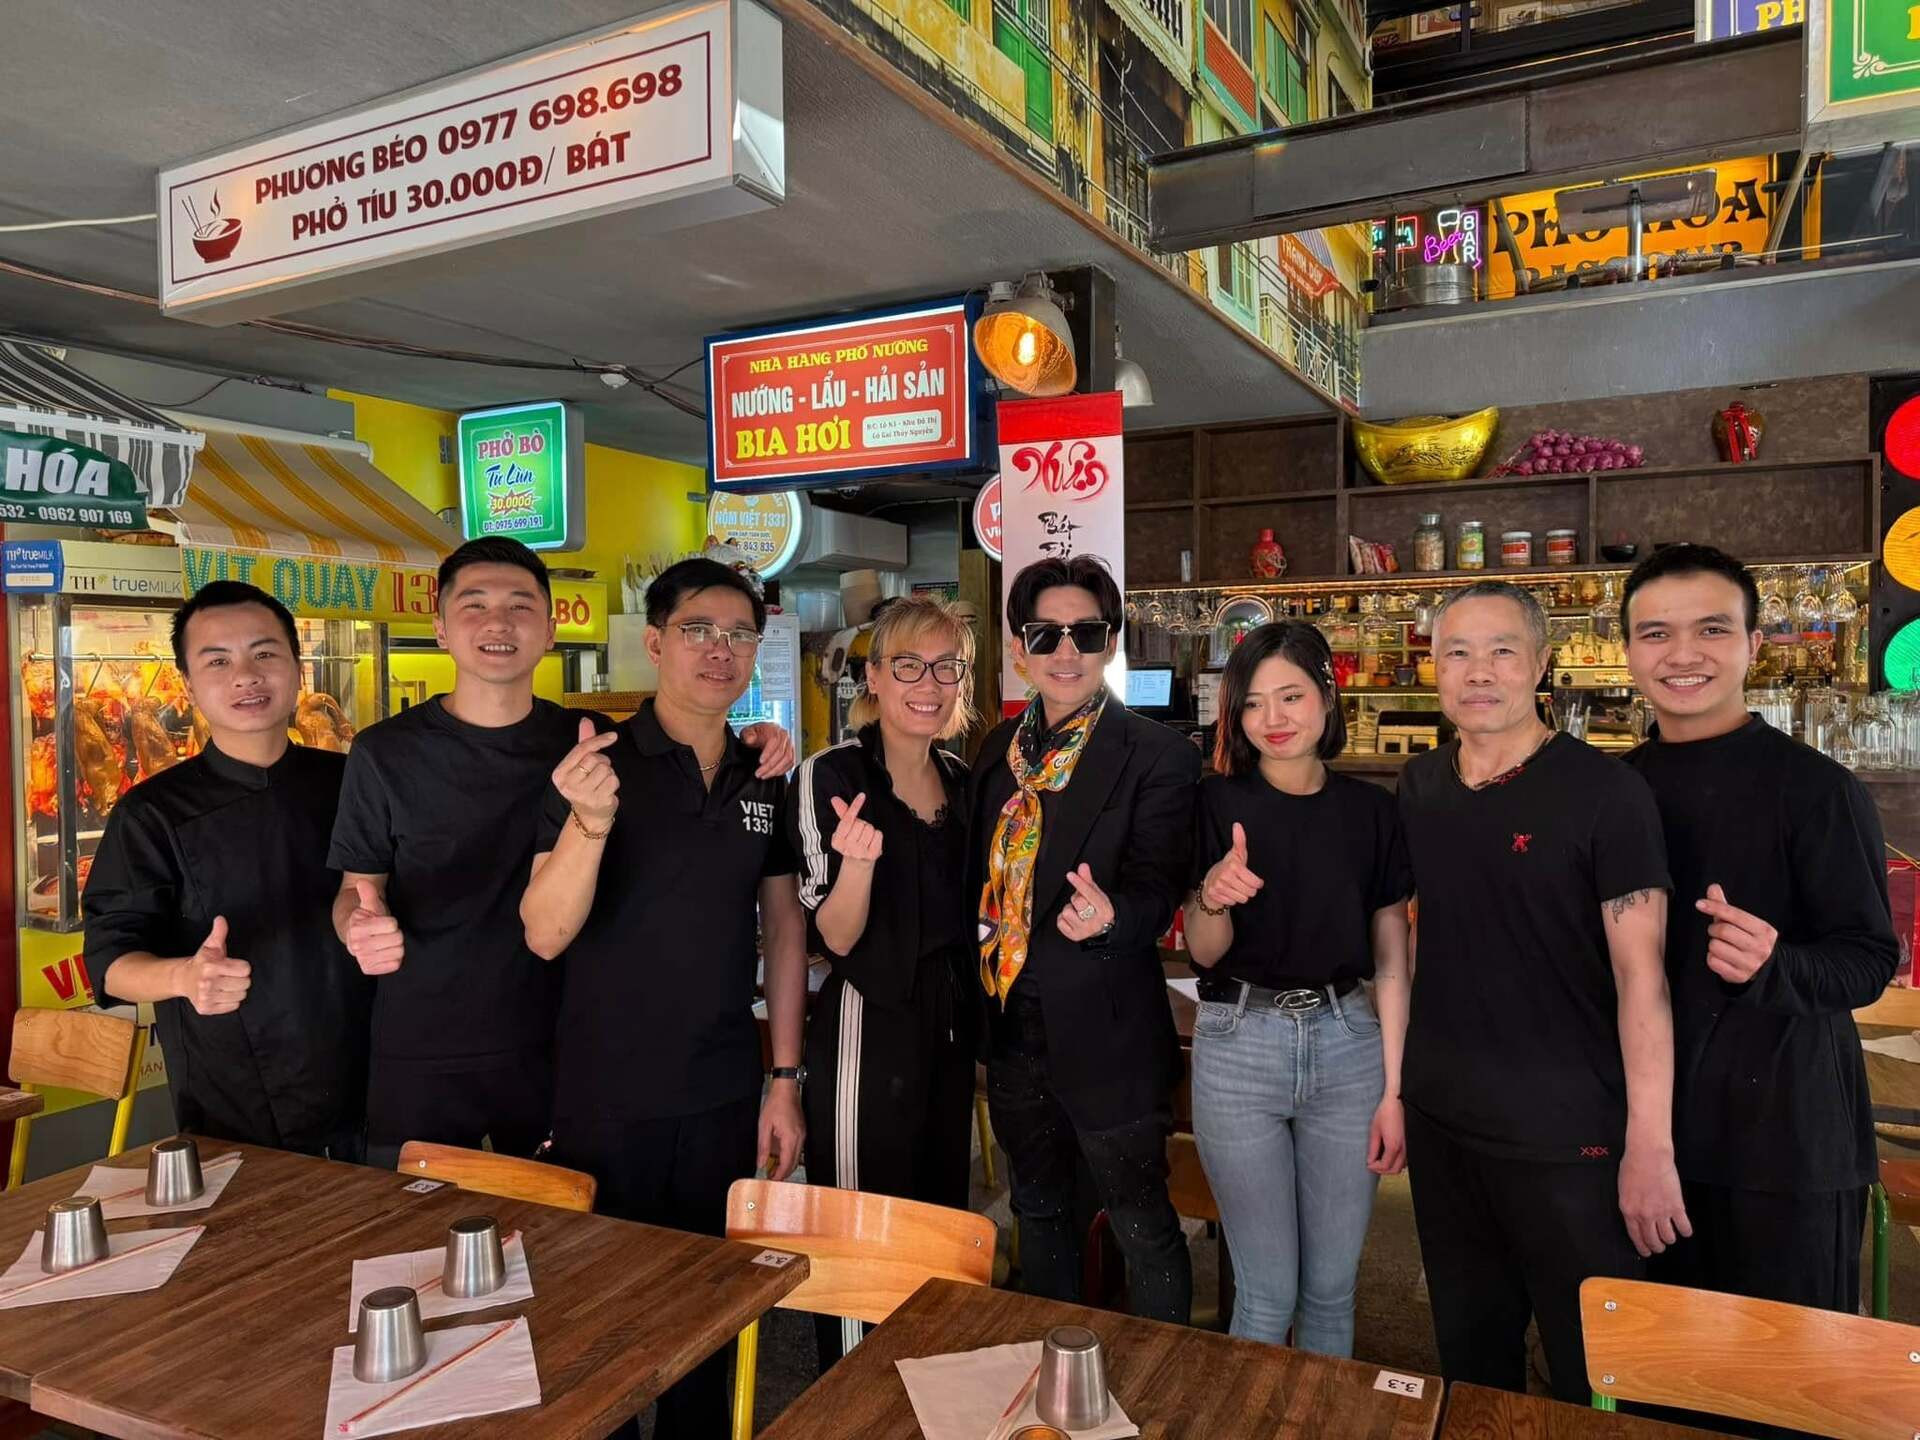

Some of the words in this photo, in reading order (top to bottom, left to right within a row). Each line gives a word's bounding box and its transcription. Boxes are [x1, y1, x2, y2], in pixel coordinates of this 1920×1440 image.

[255, 150, 365, 204] PHƯƠNG
[373, 135, 427, 173] BÉO
[438, 109, 518, 155] 0977
[529, 64, 683, 131] 698.698
[292, 195, 348, 240] PHỞ
[357, 188, 397, 224] TÍU
[566, 131, 631, 175] BÁT
[1424, 229, 1465, 263] Beer
[1462, 215, 1477, 263] BAR
[732, 383, 793, 418] NƯỚNG
[811, 370, 846, 410] LẨU
[865, 365, 897, 404] HẢI
[904, 361, 945, 399] SẢN
[478, 430, 514, 460] PHỞ
[519, 428, 544, 454] BÒ
[735, 425, 788, 459] BIA
[796, 415, 852, 453] HƠI
[5, 447, 110, 497] HÓA
[38, 506, 76, 522] 0962
[79, 508, 104, 523] 907
[108, 510, 133, 524] 169
[70, 575, 96, 590] TH
[273, 557, 379, 612] QUAY
[555, 593, 590, 625] BÒ
[740, 800, 775, 818] VIET
[743, 816, 773, 836] 1331
[1387, 1378, 1418, 1393] 3.3
